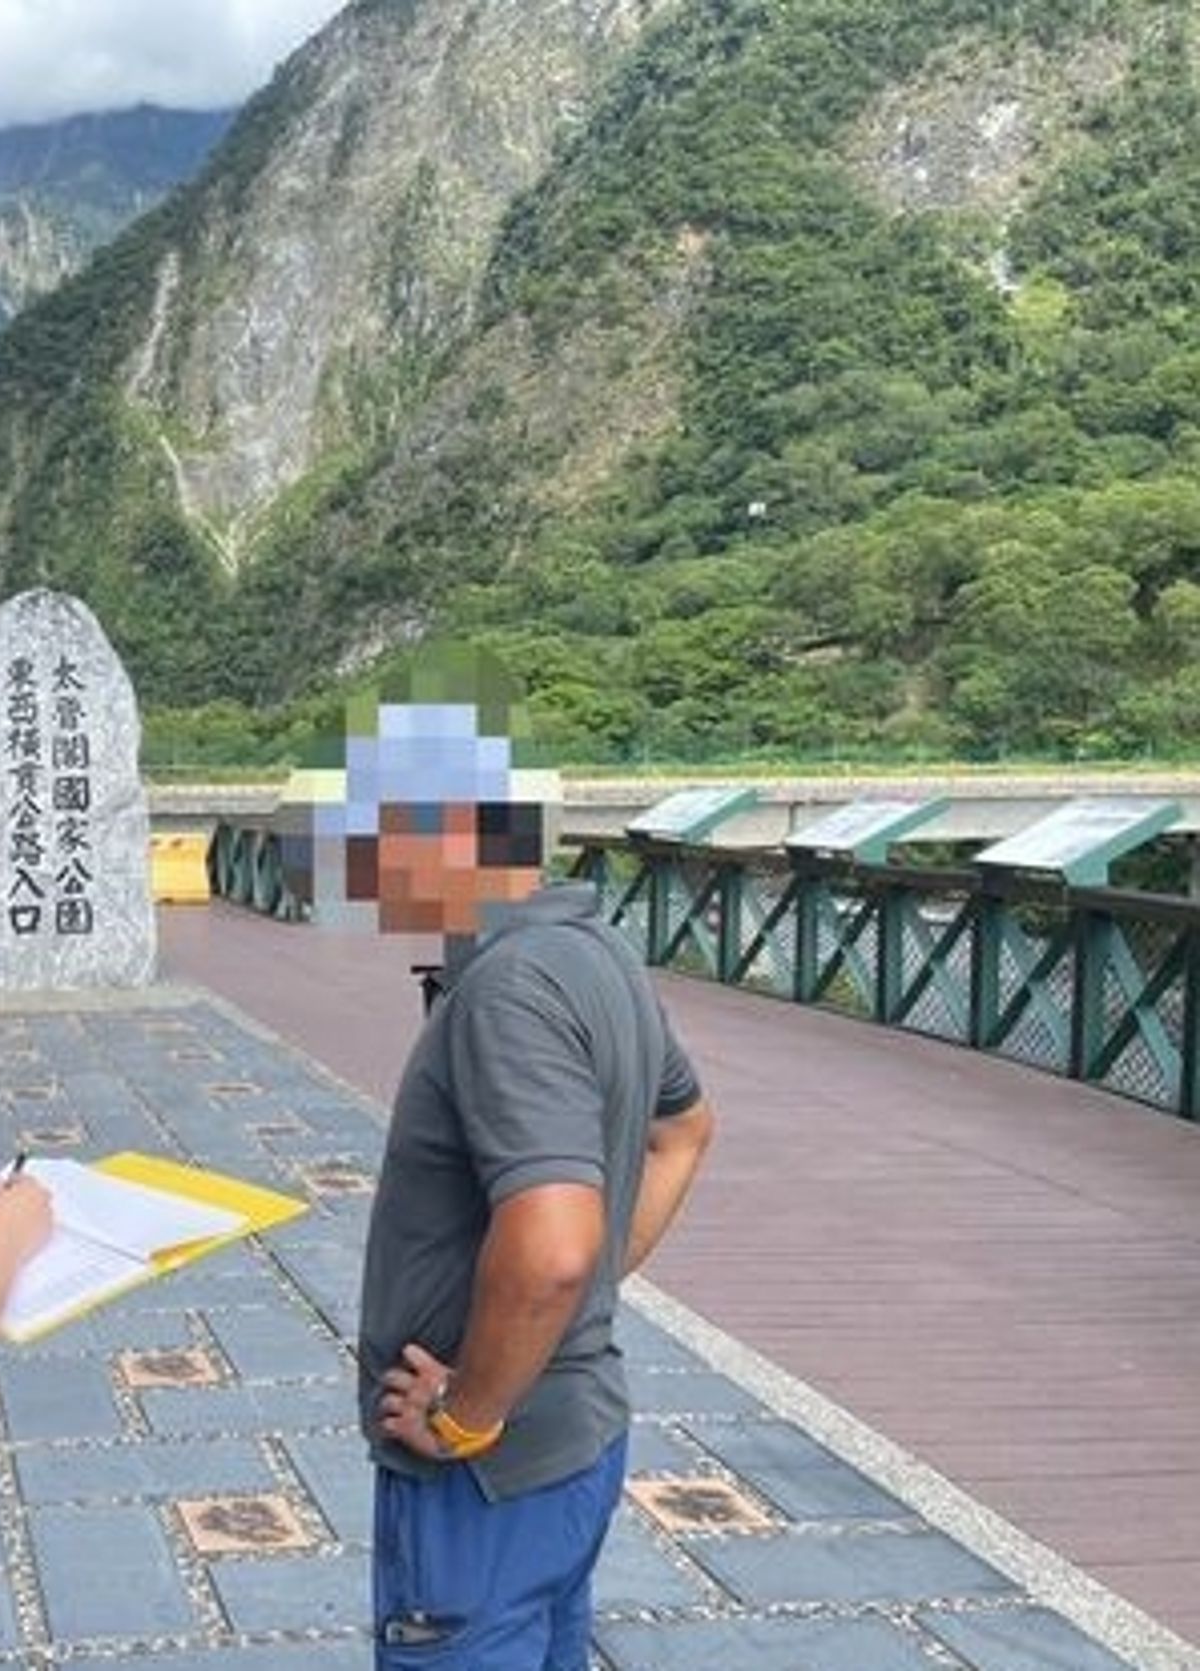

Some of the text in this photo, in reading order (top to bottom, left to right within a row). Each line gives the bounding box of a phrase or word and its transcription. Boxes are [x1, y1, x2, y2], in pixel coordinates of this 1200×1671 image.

[51, 654, 94, 935] 太魯閣國家公園
